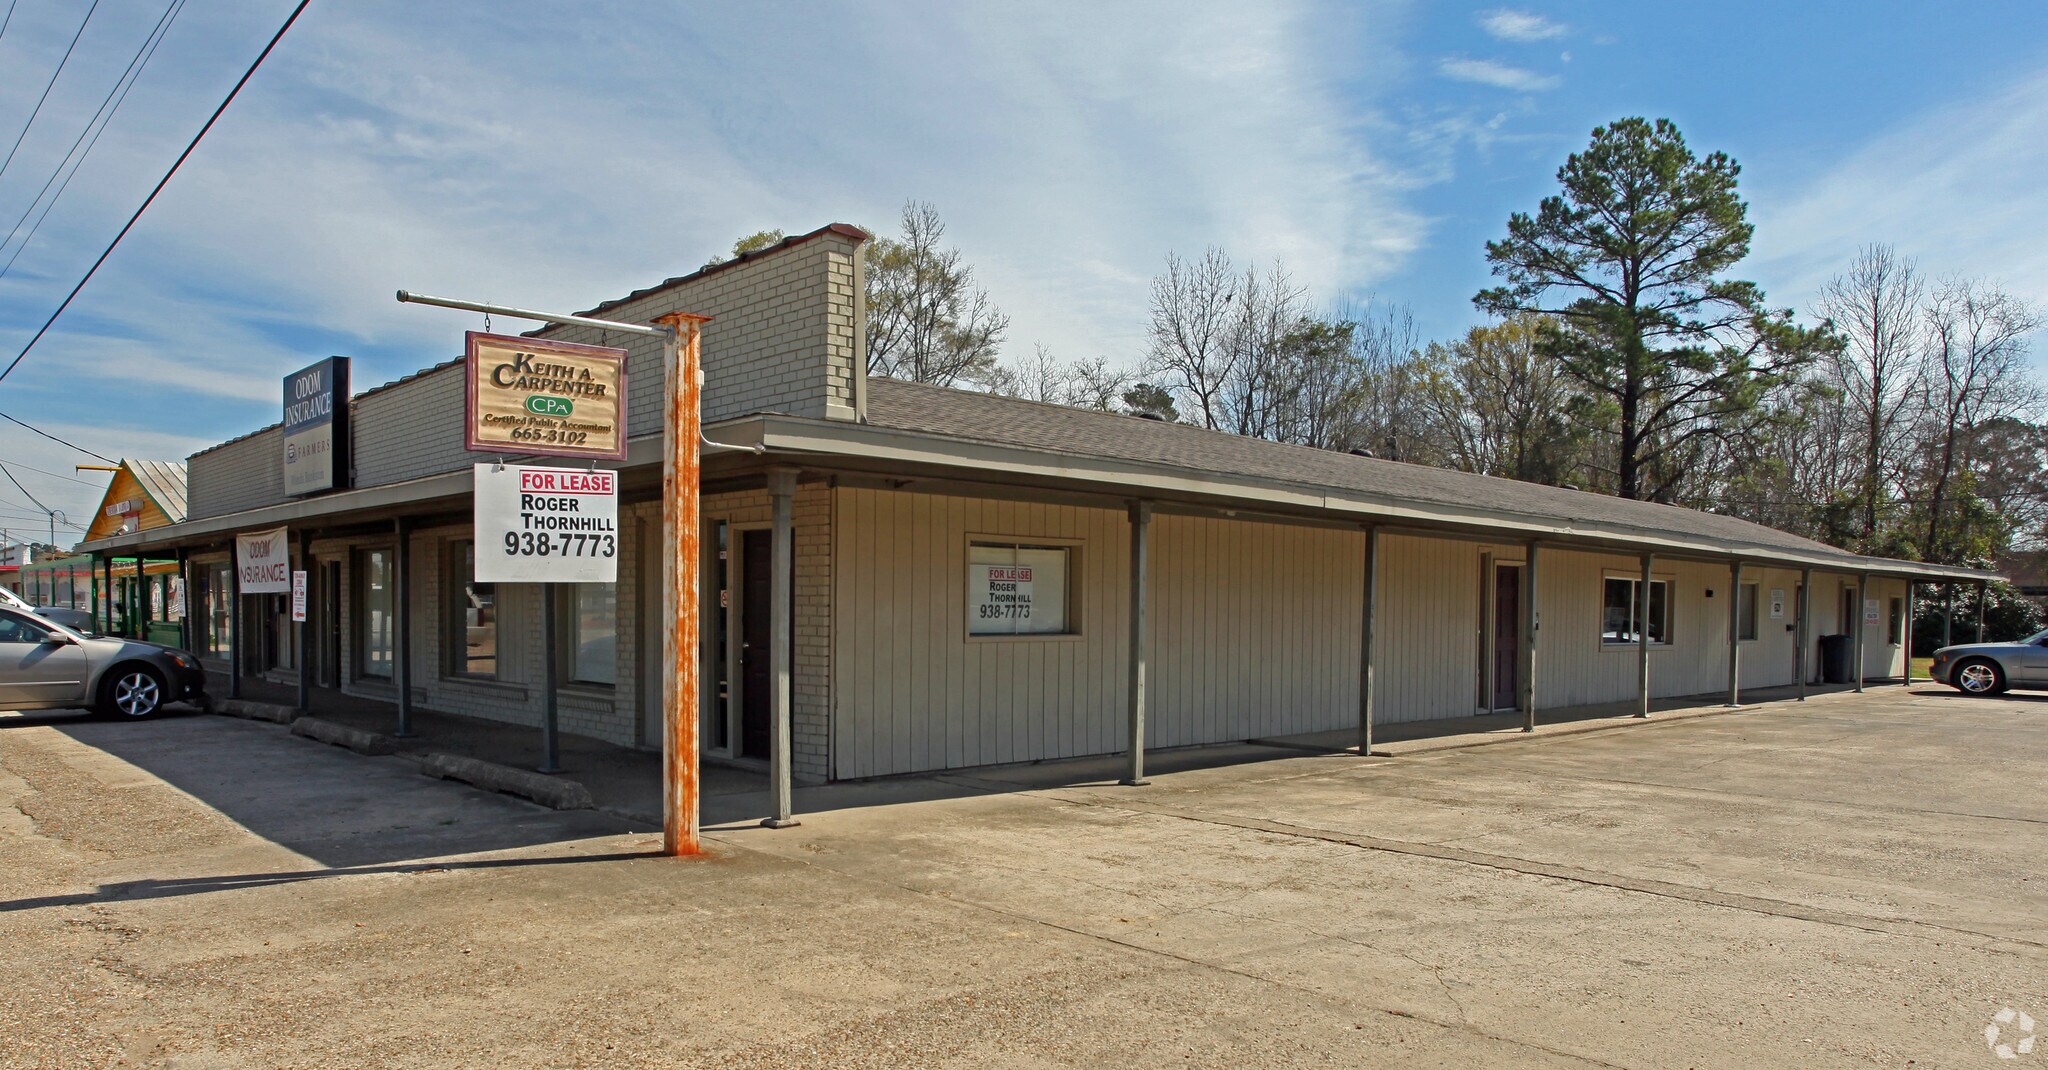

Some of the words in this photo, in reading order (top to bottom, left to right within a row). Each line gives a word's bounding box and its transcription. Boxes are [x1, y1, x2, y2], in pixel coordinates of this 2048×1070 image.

[513, 353, 575, 379] KEITH
[579, 368, 595, 382] A.
[295, 371, 321, 399] ODOM
[493, 363, 607, 396] CARPENTER
[286, 392, 331, 427] INSURANCE
[532, 398, 568, 414] CPA
[485, 413, 526, 425] Certified
[529, 418, 558, 428] Public
[560, 420, 611, 432] Accountant
[512, 427, 587, 444] 665-3102
[298, 439, 330, 459] FARMERS
[522, 474, 555, 489] FOR
[561, 475, 611, 491] LEASE
[521, 494, 579, 512] ROGER
[520, 513, 614, 531] THORNHILL
[250, 540, 270, 559] ODOM
[505, 531, 615, 558] 938-7773
[240, 563, 286, 583] NSURANCE
[989, 569, 1005, 579] FOR
[989, 581, 1016, 592] ROGER
[980, 604, 1030, 619] 938-7773
